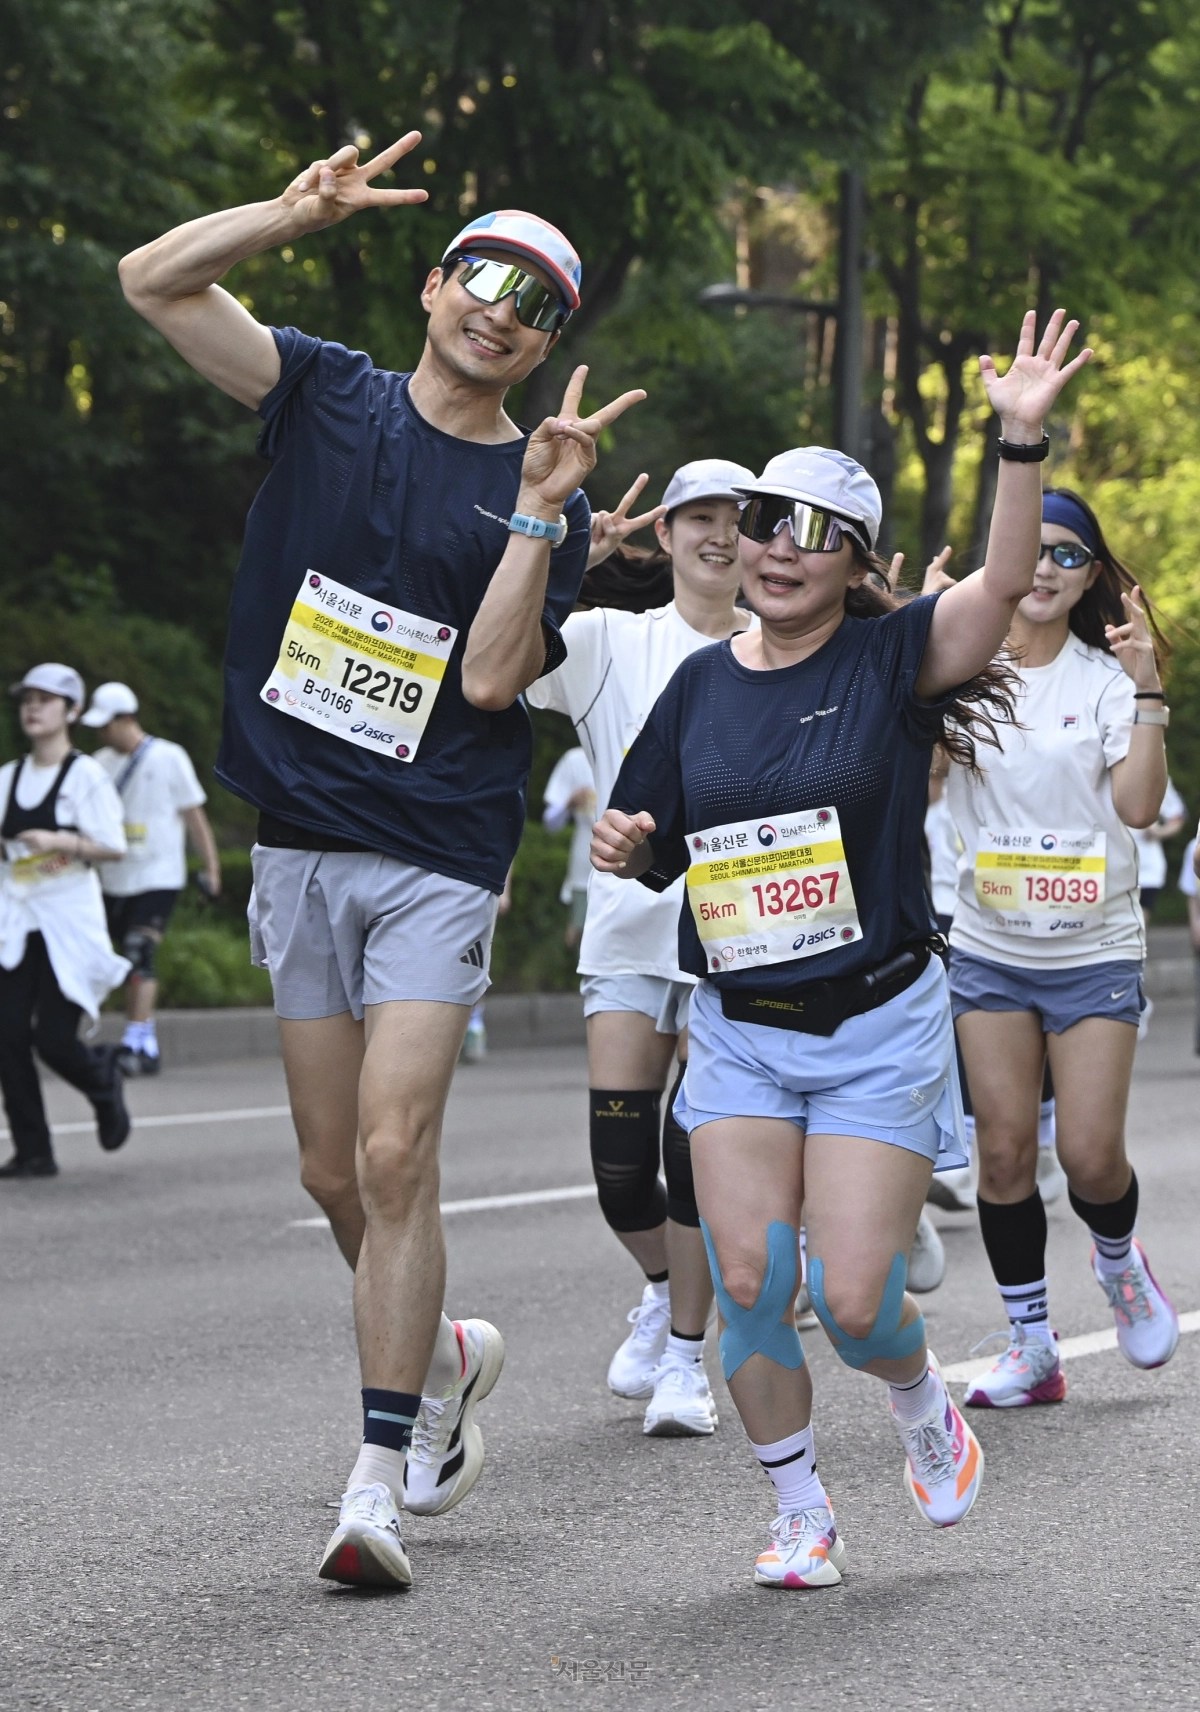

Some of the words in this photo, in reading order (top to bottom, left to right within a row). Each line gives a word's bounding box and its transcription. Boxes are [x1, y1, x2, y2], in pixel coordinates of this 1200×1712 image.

[314, 588, 363, 620] 서울신문
[312, 622, 330, 636] SEOUL
[330, 631, 360, 649] SHINMUN
[359, 644, 377, 655] HALF
[377, 651, 415, 670] MARATHON
[314, 613, 334, 628] 2026
[335, 623, 418, 662] 서울신문하프마라톤대회
[286, 640, 321, 671] 5km
[302, 678, 354, 714] B-0166
[340, 656, 423, 714] 12219
[364, 726, 396, 744] asics
[780, 821, 826, 838] 인사혁신처
[991, 834, 1032, 848] 서울신문
[708, 861, 730, 873] 2026
[732, 847, 813, 869] 서울신문하프마라톤대회
[710, 871, 730, 881] SEOUL
[732, 867, 761, 878] SHINMUN
[761, 863, 778, 873] HALF
[780, 857, 814, 869] MARATHON
[752, 871, 840, 917] 13267
[982, 881, 1012, 896] 5km
[1025, 876, 1098, 904] 13039
[699, 902, 738, 921] 5km
[807, 926, 836, 946] asics
[736, 944, 768, 958] 한화생명
